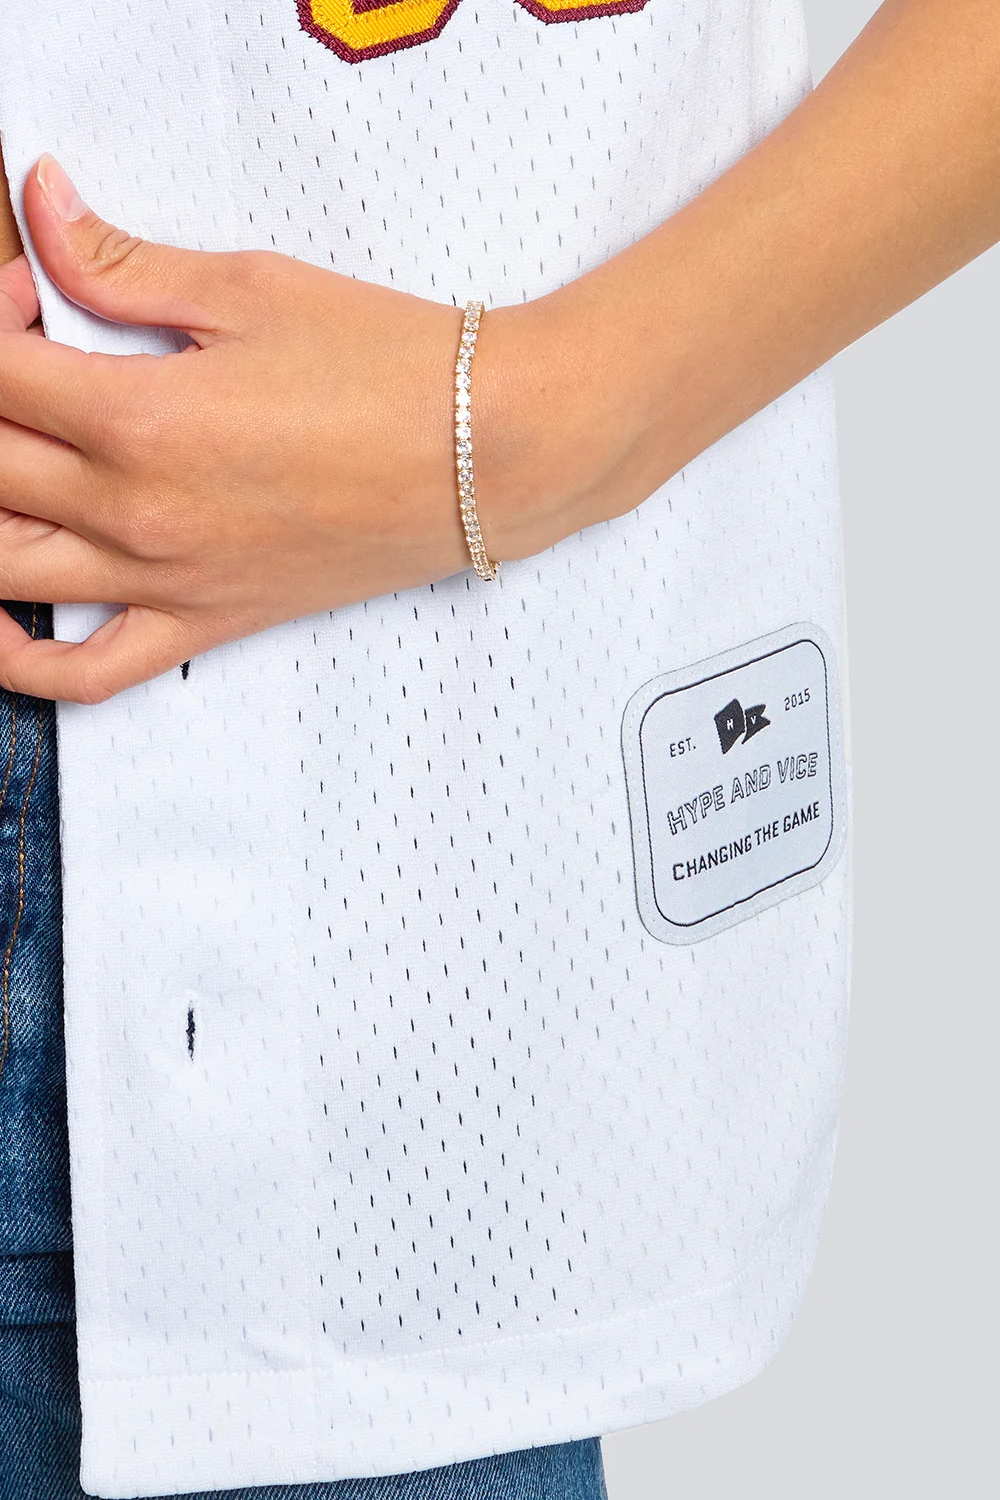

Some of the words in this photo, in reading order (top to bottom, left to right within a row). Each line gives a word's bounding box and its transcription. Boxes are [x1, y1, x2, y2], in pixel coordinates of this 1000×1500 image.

[669, 737, 697, 758] EST.
[784, 688, 811, 711] 2015
[667, 785, 726, 835] HYPE
[730, 765, 772, 803] AND
[777, 752, 818, 784] VICE
[672, 835, 752, 881] CHANGING
[754, 820, 780, 846] THE
[783, 801, 820, 833] GAME
